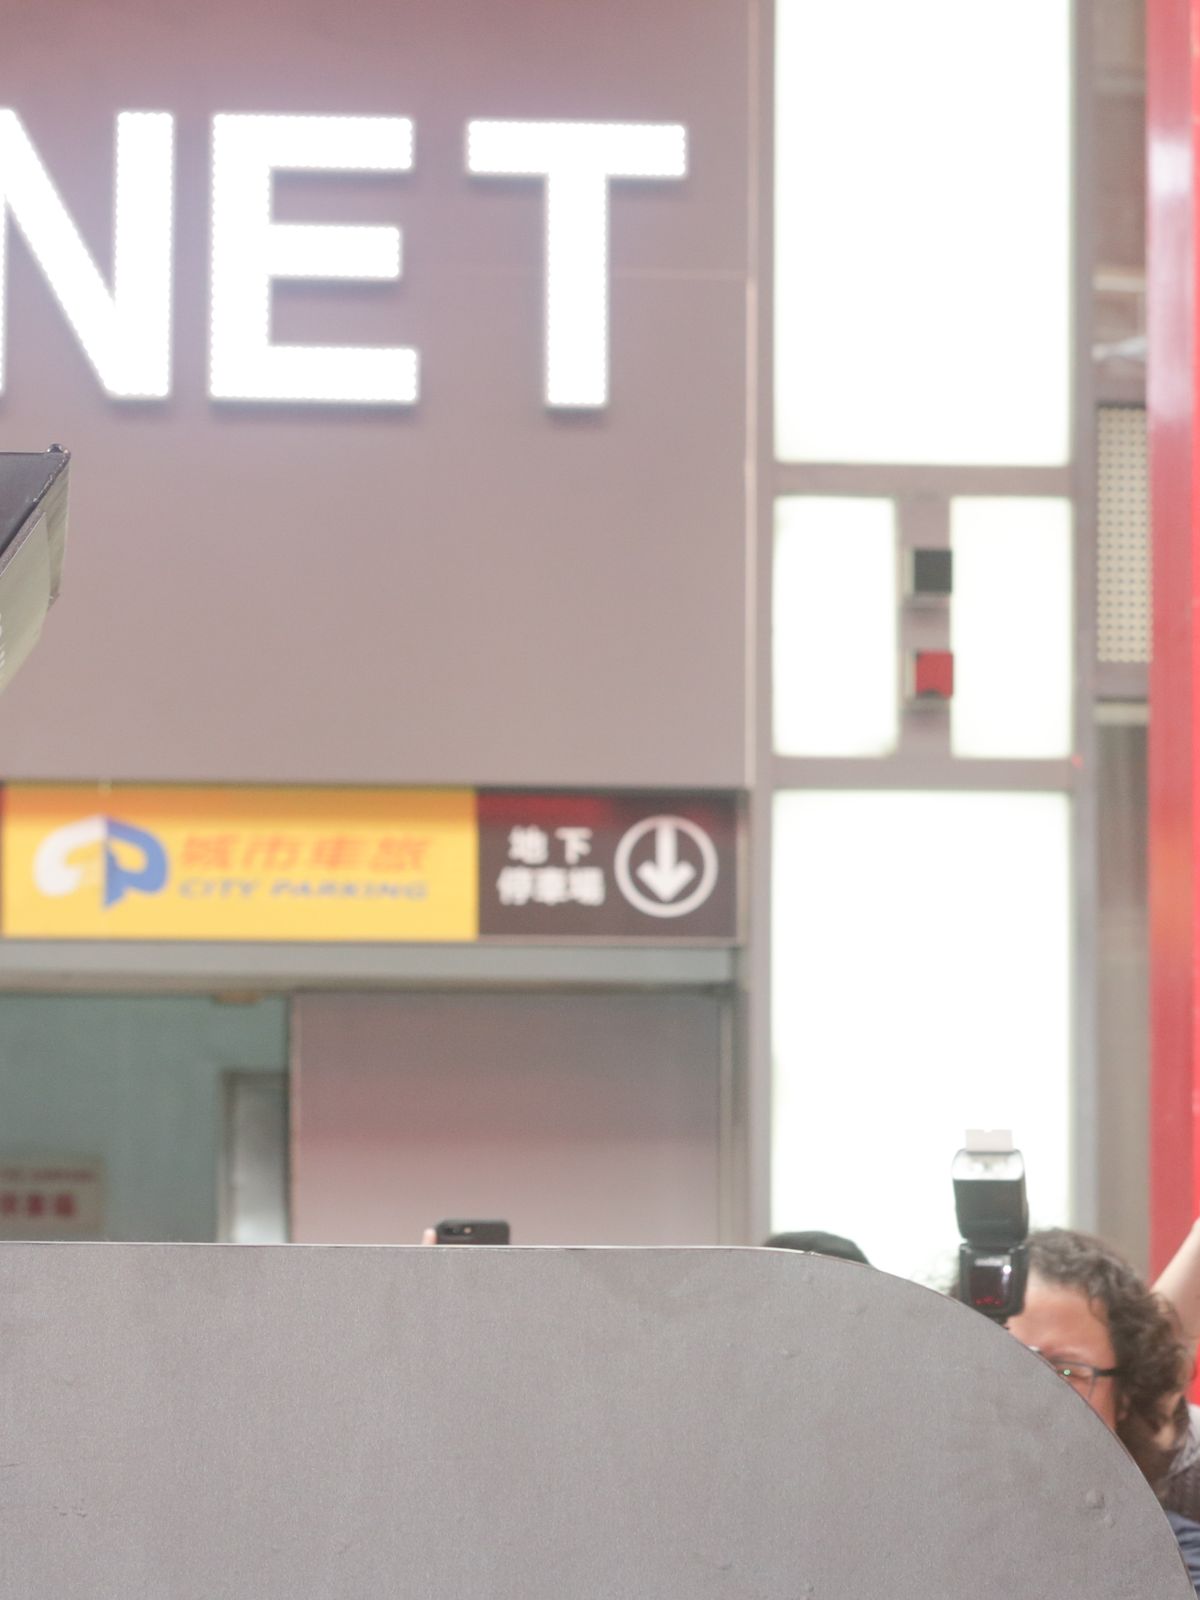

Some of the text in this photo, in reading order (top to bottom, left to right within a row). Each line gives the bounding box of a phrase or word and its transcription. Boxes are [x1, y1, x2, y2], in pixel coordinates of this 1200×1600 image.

[0, 110, 687, 406] NET
[508, 826, 593, 865] 地下
[179, 878, 429, 900] CITY PARKING
[497, 866, 605, 906] 停車場
